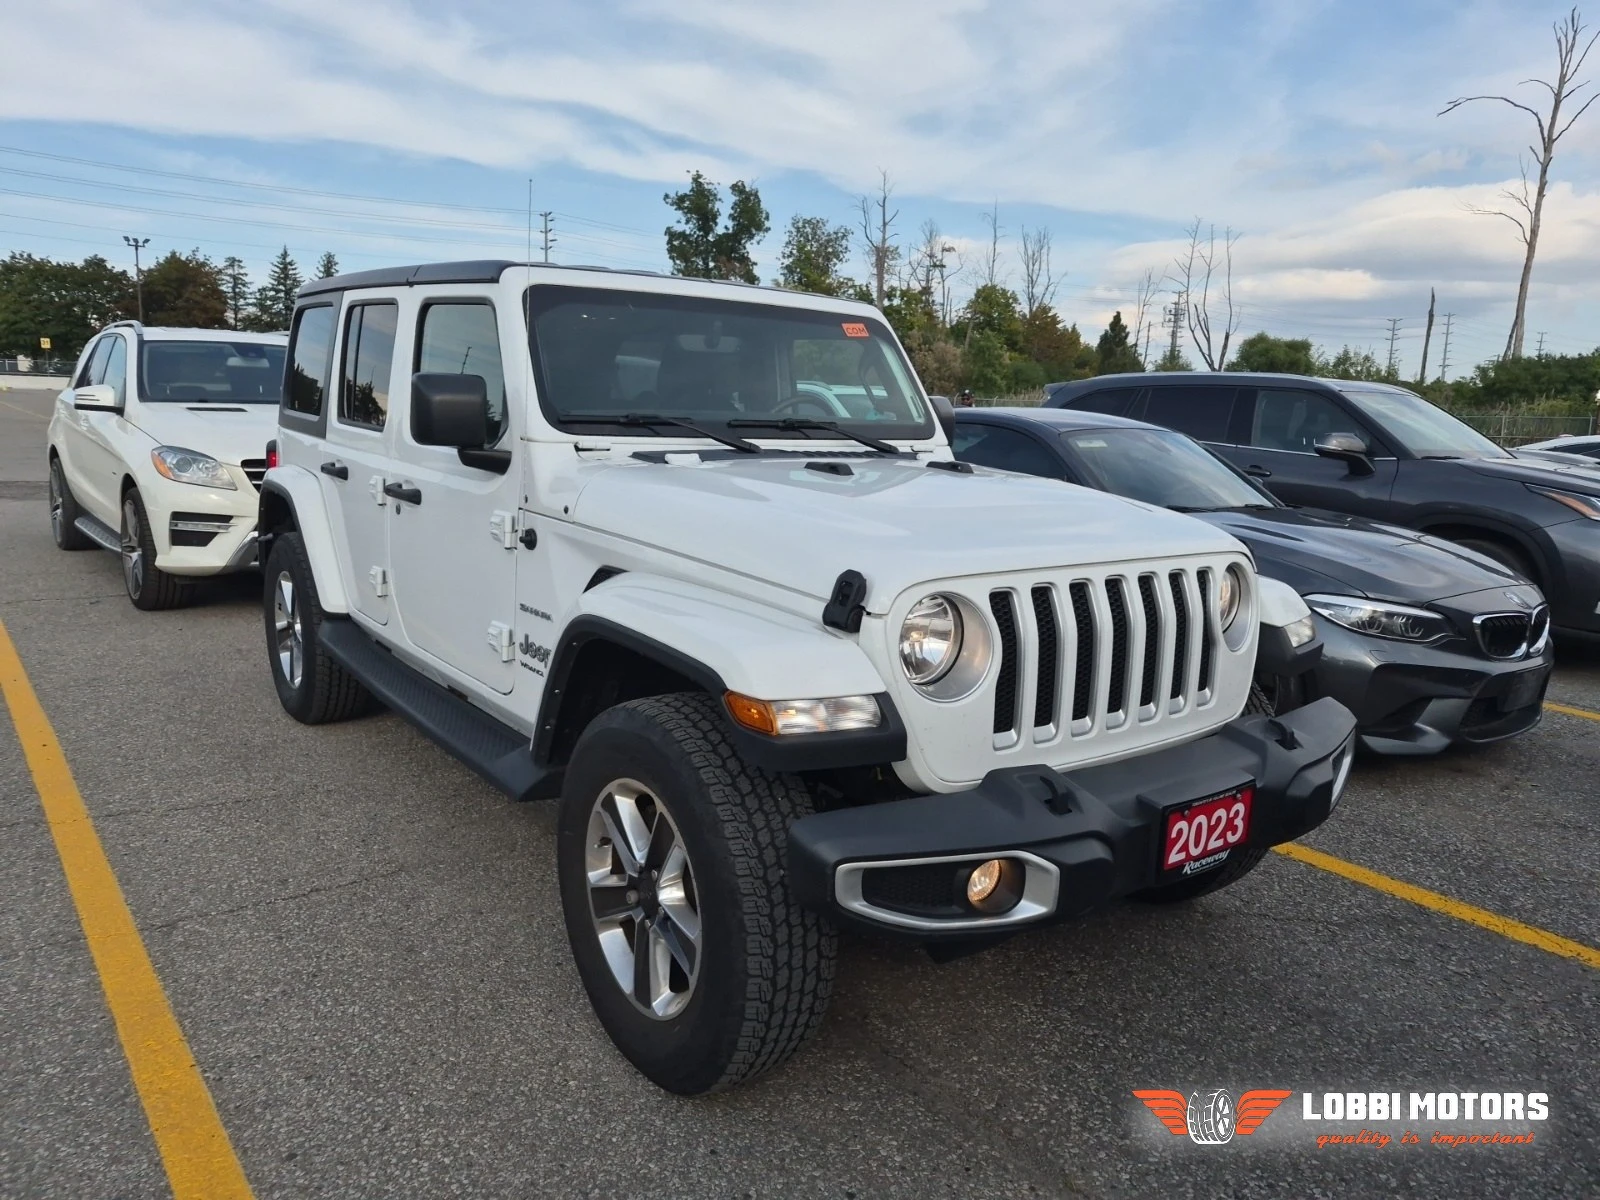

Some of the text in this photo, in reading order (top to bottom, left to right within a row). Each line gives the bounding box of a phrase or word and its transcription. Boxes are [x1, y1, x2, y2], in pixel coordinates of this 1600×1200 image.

[519, 633, 552, 669] Jeep
[1167, 802, 1245, 864] 2023
[1182, 849, 1231, 875] Raceway
